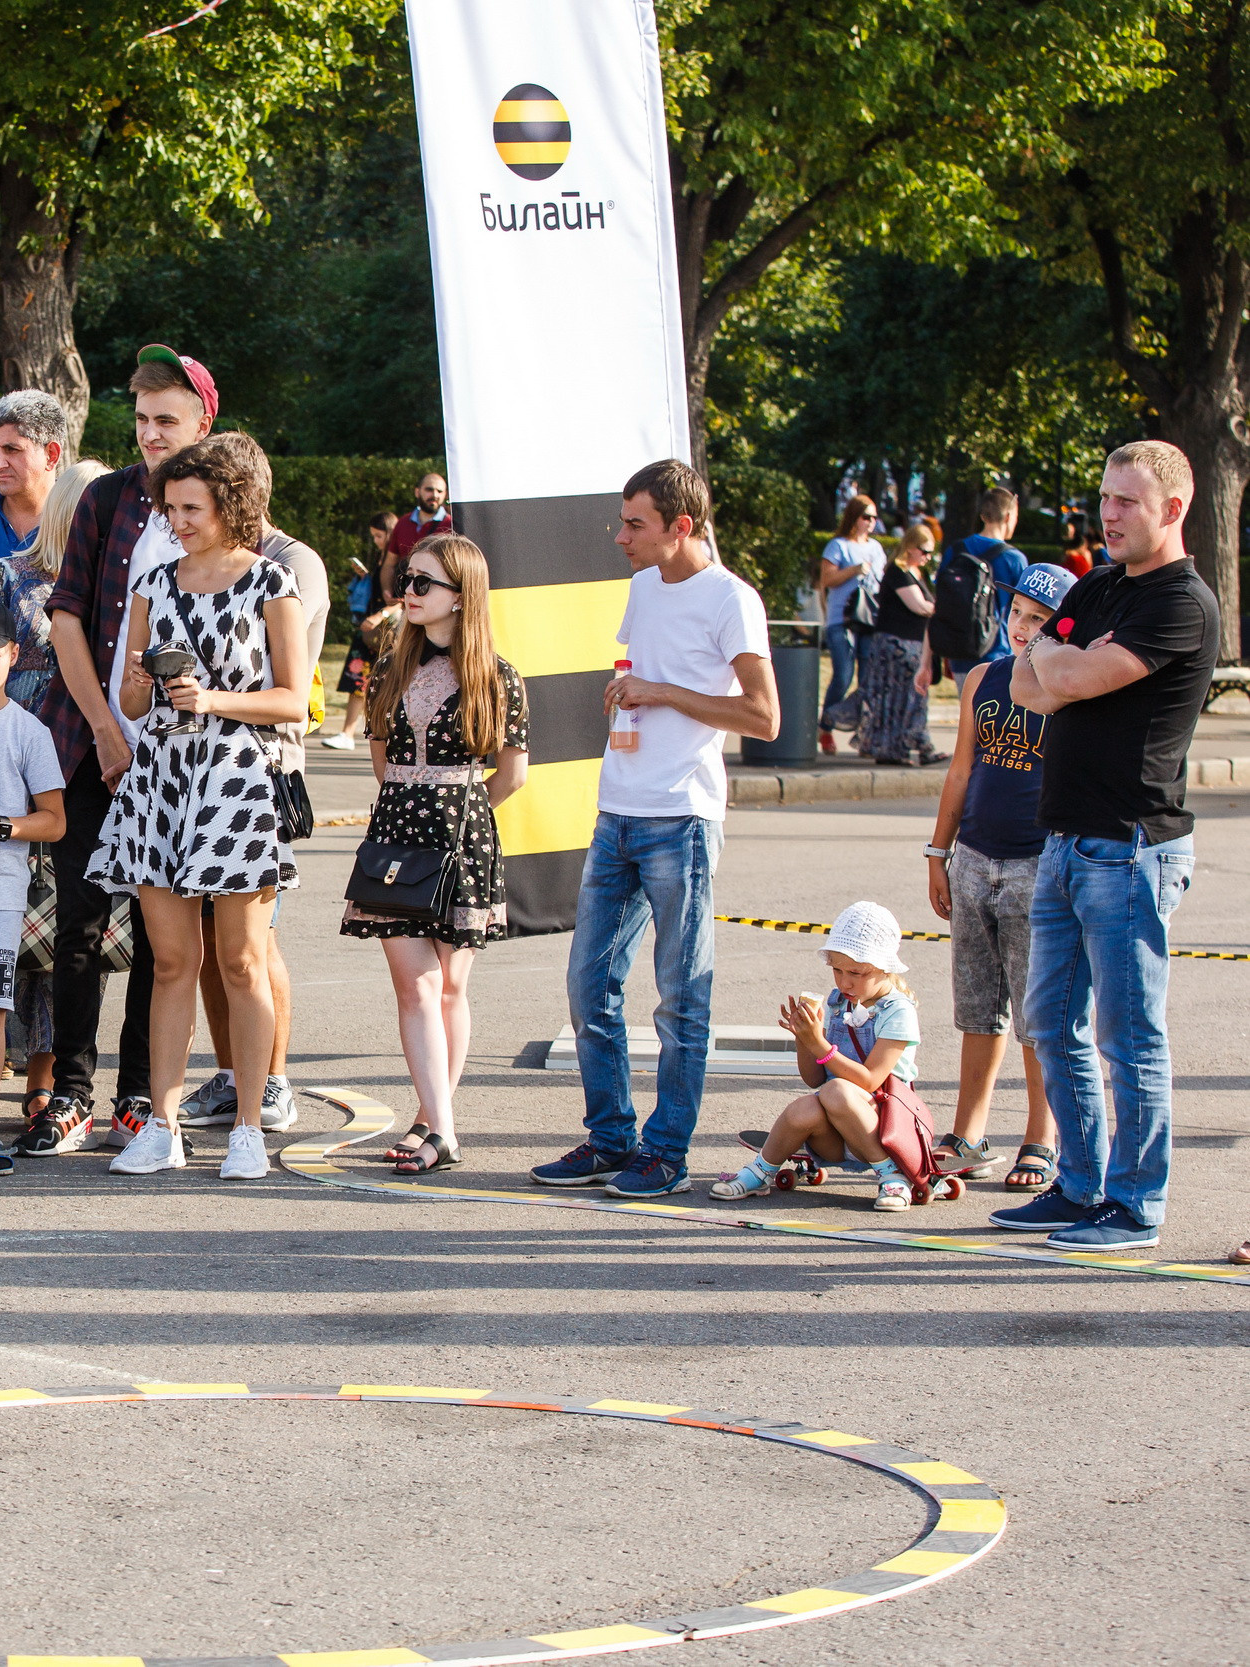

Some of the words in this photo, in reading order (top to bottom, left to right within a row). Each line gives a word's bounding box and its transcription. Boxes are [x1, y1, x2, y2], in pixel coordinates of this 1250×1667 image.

[1023, 575, 1058, 599] YORK
[1033, 569, 1059, 587] NEW
[990, 746, 1028, 760] NY/SF
